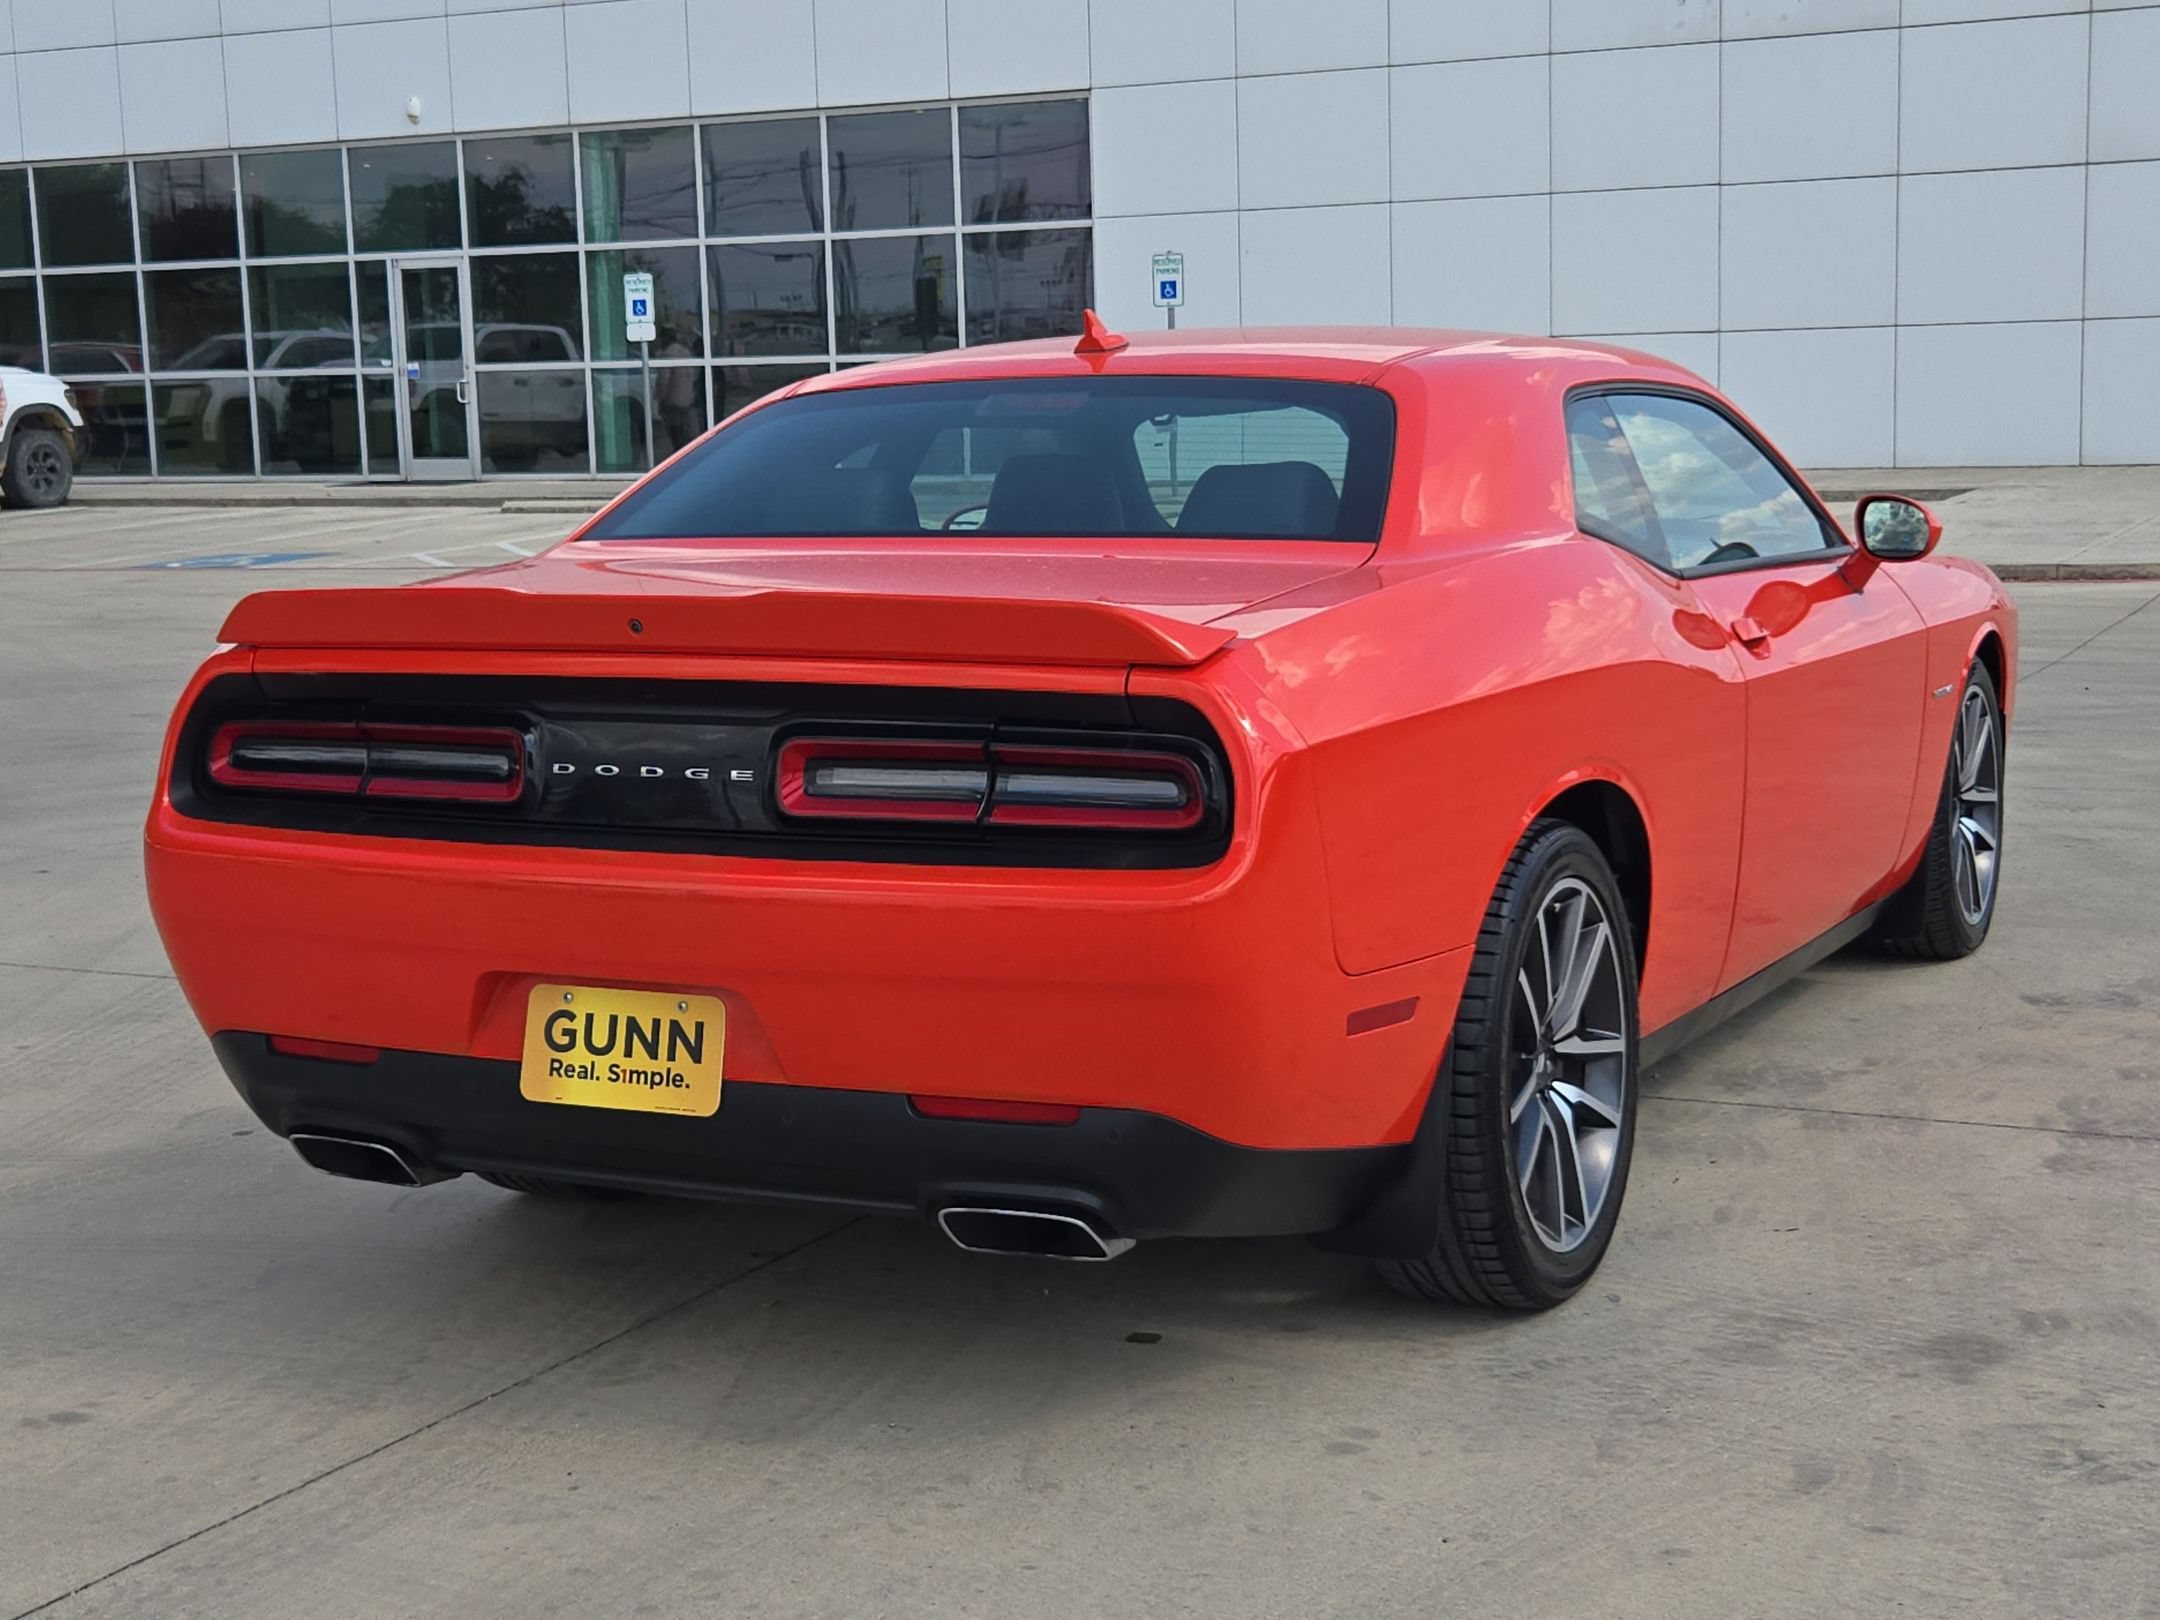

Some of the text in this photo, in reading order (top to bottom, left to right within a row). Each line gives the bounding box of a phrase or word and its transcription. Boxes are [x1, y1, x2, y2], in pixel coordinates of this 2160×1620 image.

[552, 763, 754, 781] DODGE
[543, 1008, 705, 1065] GUNN
[549, 1058, 600, 1081] Real.
